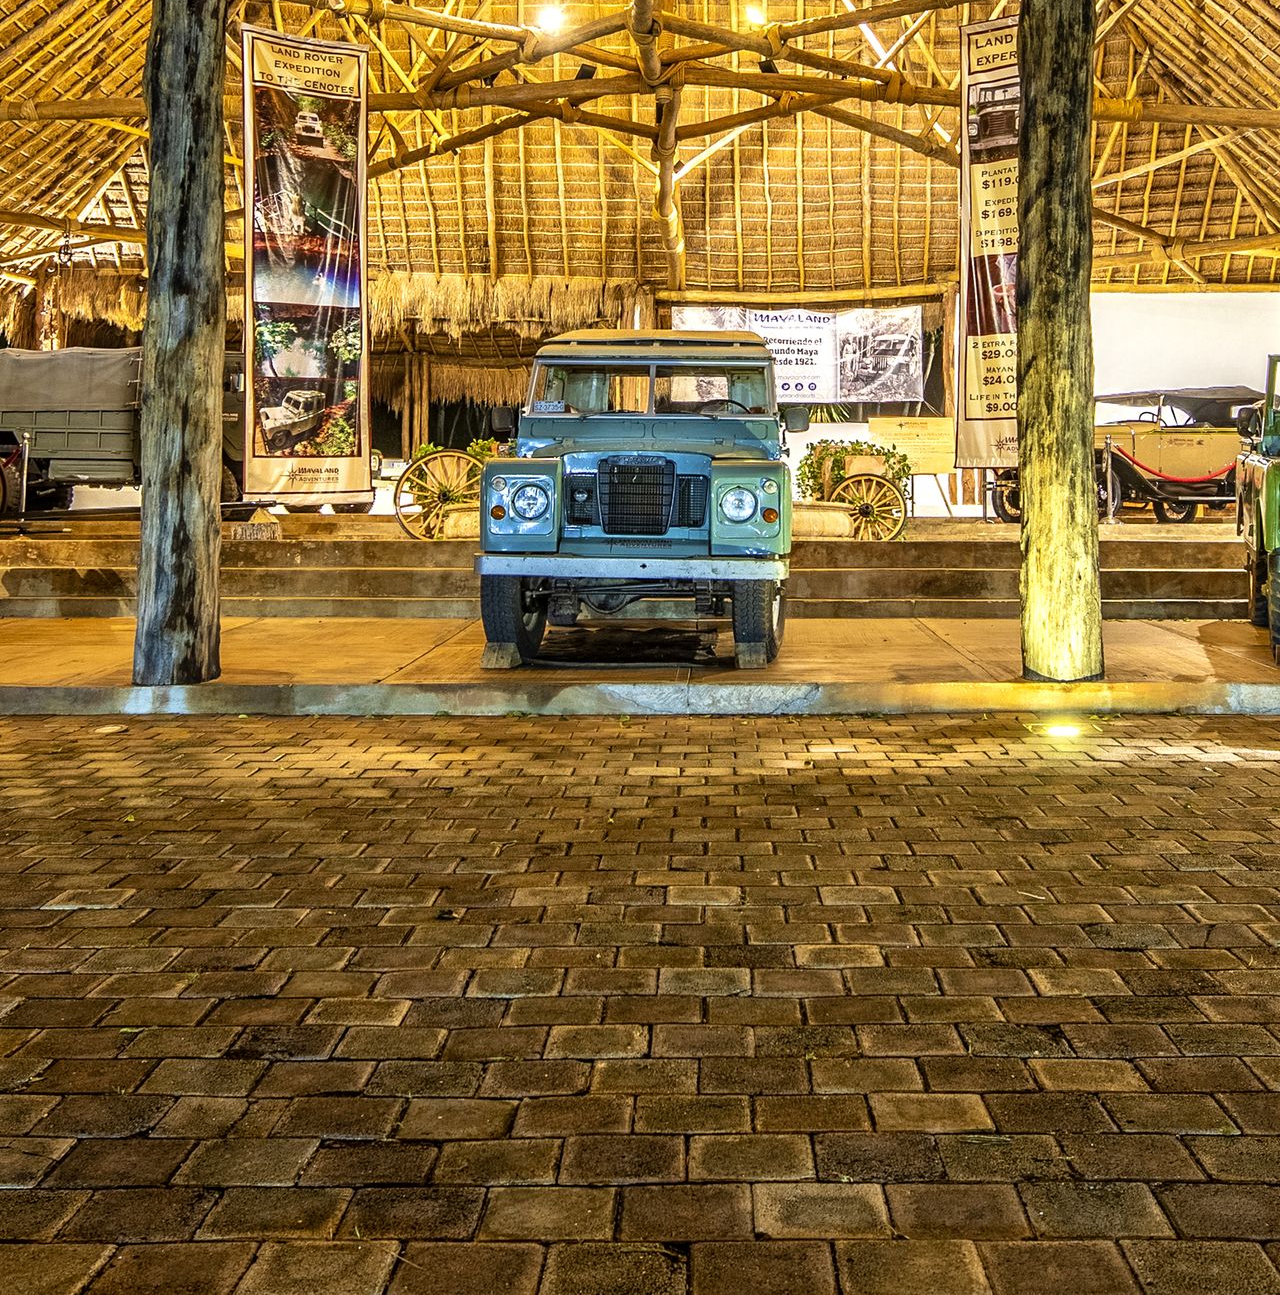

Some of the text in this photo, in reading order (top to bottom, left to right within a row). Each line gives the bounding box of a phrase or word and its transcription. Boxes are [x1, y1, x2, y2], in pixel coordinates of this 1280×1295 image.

[975, 34, 1014, 50] LAND
[271, 45, 343, 65] LAND ROVER
[274, 59, 341, 79] EXPEDITION
[259, 71, 274, 82] TO
[304, 80, 355, 94] CENOTES
[754, 312, 831, 324] MAYALAND
[814, 337, 822, 346] el
[972, 341, 979, 349] 2
[982, 340, 1007, 349] EXTRA
[796, 348, 819, 357] Maya
[773, 357, 793, 366] esde
[982, 374, 1017, 387] $24.0
[969, 393, 991, 401] LIFE
